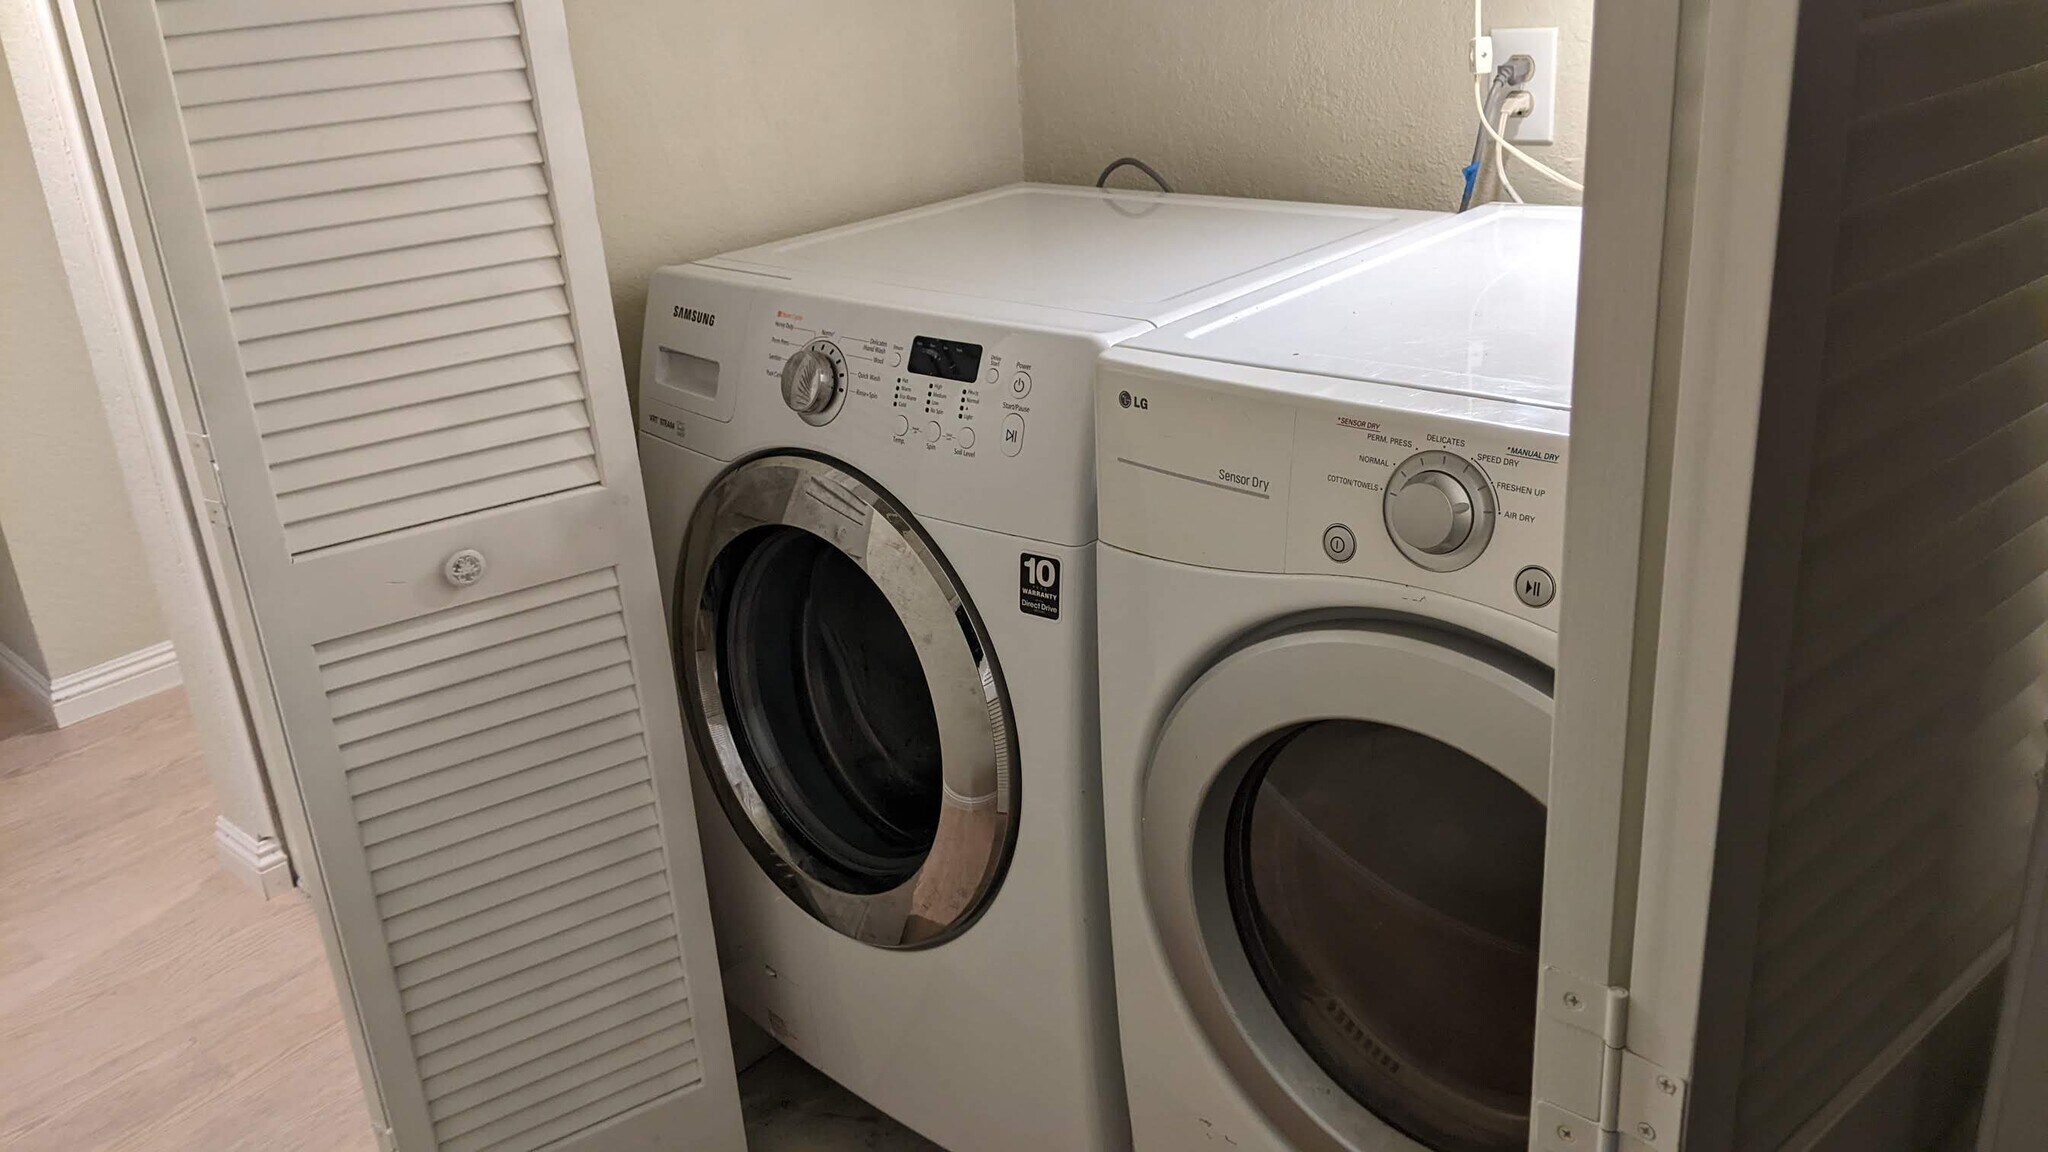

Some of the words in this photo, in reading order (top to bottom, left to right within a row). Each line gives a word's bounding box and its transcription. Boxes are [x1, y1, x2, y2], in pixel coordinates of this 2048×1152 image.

[673, 305, 715, 327] SAMSUNG
[1016, 361, 1032, 371] Power
[1002, 401, 1031, 413] Start/Pause
[1133, 396, 1149, 410] LG
[1366, 421, 1381, 430] DRY
[926, 443, 937, 452] Spin
[1367, 433, 1389, 444] PERM.
[1389, 437, 1413, 449] PRESS
[1426, 433, 1466, 448] DELICATES
[953, 448, 964, 457] Soil
[963, 449, 976, 459] Level
[1477, 453, 1502, 465] SPEED
[1503, 457, 1520, 468] DRY
[1543, 454, 1561, 462] DRY
[1358, 455, 1390, 468] NORMAL
[1218, 468, 1251, 486] Sensor
[1251, 476, 1270, 491] Dry
[1327, 474, 1379, 492] COTTON/TOWELS
[1496, 481, 1533, 495] FRESHEN
[1534, 488, 1547, 497] UP
[1503, 511, 1518, 520] AIR
[1518, 513, 1536, 523] DRY
[1023, 557, 1056, 588] 10
[1022, 587, 1057, 601] WARRANTY
[1021, 598, 1040, 609] Direct
[1041, 603, 1058, 613] Drive
